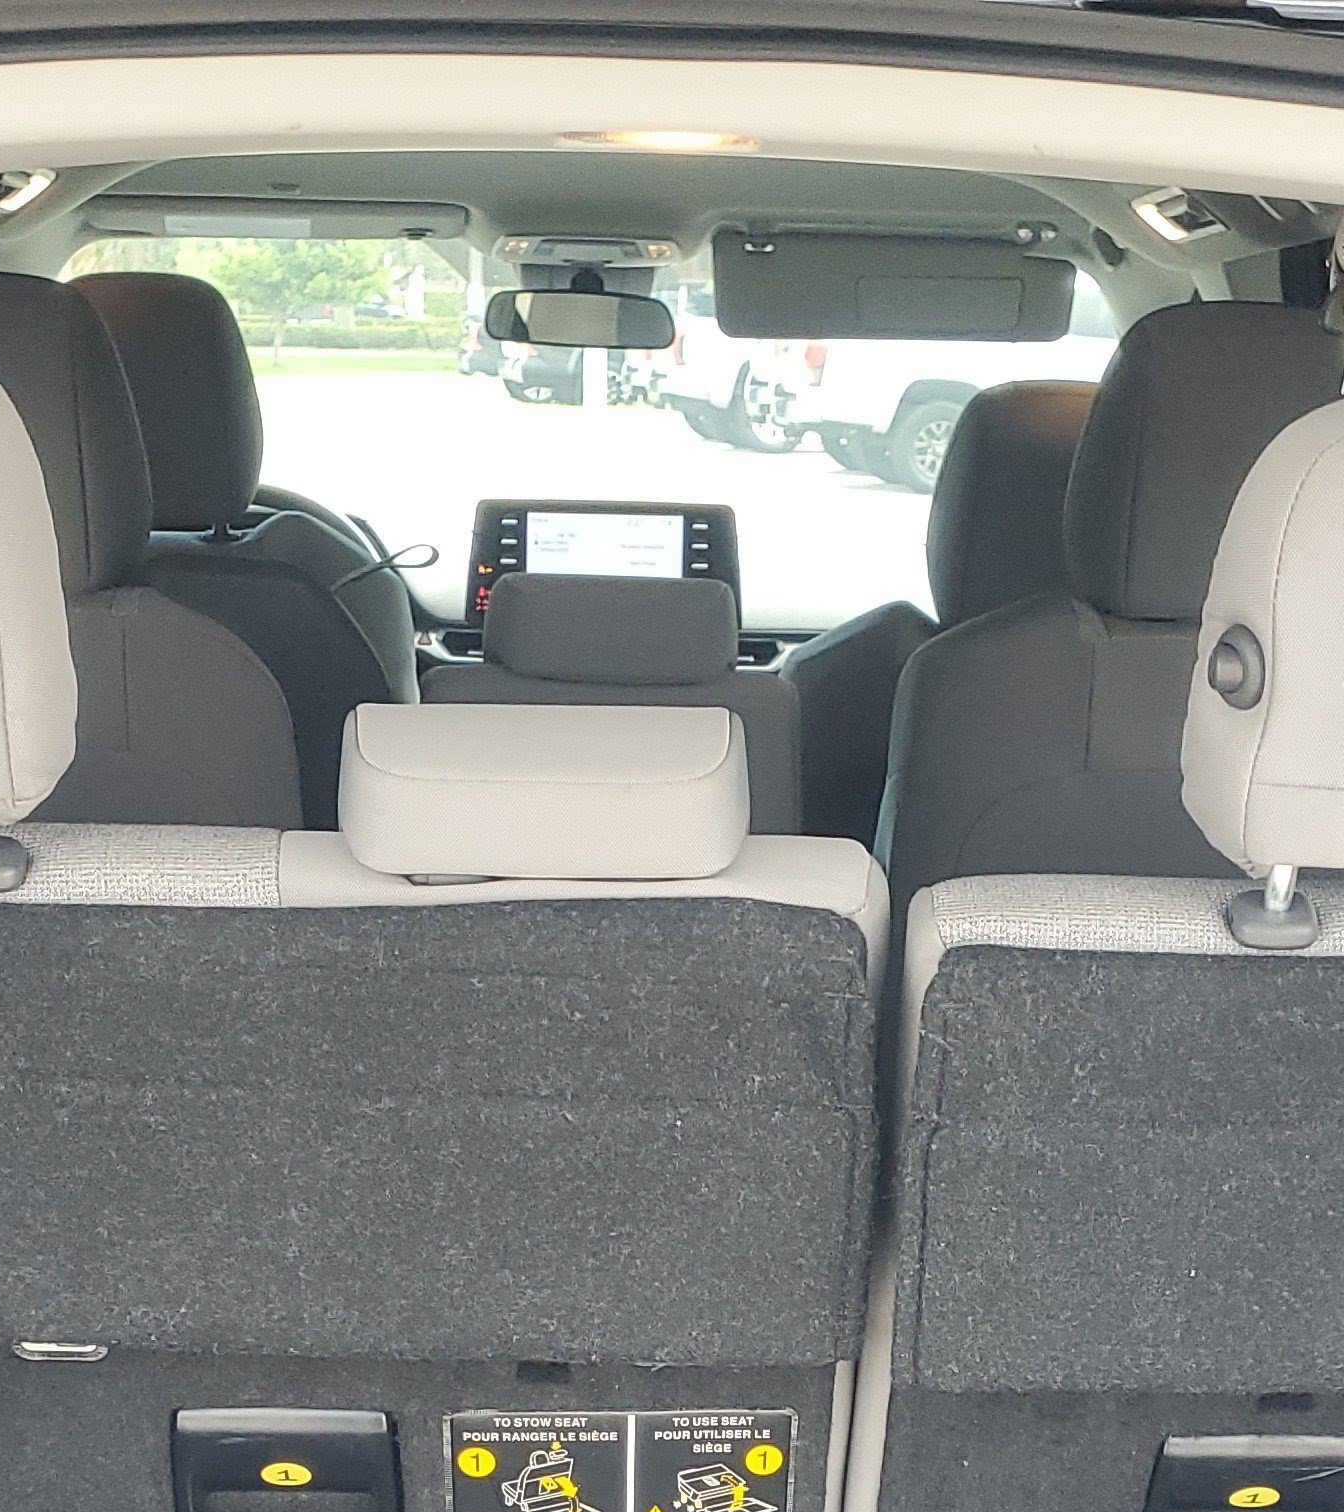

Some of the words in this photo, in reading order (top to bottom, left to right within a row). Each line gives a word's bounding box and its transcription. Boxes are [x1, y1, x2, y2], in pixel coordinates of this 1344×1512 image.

[493, 1417, 511, 1428] TO
[513, 1417, 553, 1428] STOW
[554, 1417, 588, 1428] SEAT
[672, 1417, 690, 1428] TO
[692, 1417, 719, 1427] USE
[720, 1416, 755, 1427] SEAT
[462, 1432, 500, 1442] POUR
[502, 1431, 557, 1442] RANGER
[560, 1431, 576, 1442] LE
[578, 1429, 619, 1442] SIÈGE
[654, 1430, 691, 1441] POUR
[693, 1429, 753, 1440] UTILISER
[754, 1429, 771, 1440] LE
[692, 1441, 732, 1454] SIÈGE
[470, 1452, 480, 1473] 1
[757, 1450, 768, 1471] 1
[277, 1469, 297, 1481] 1
[1242, 1493, 1262, 1503] 1
